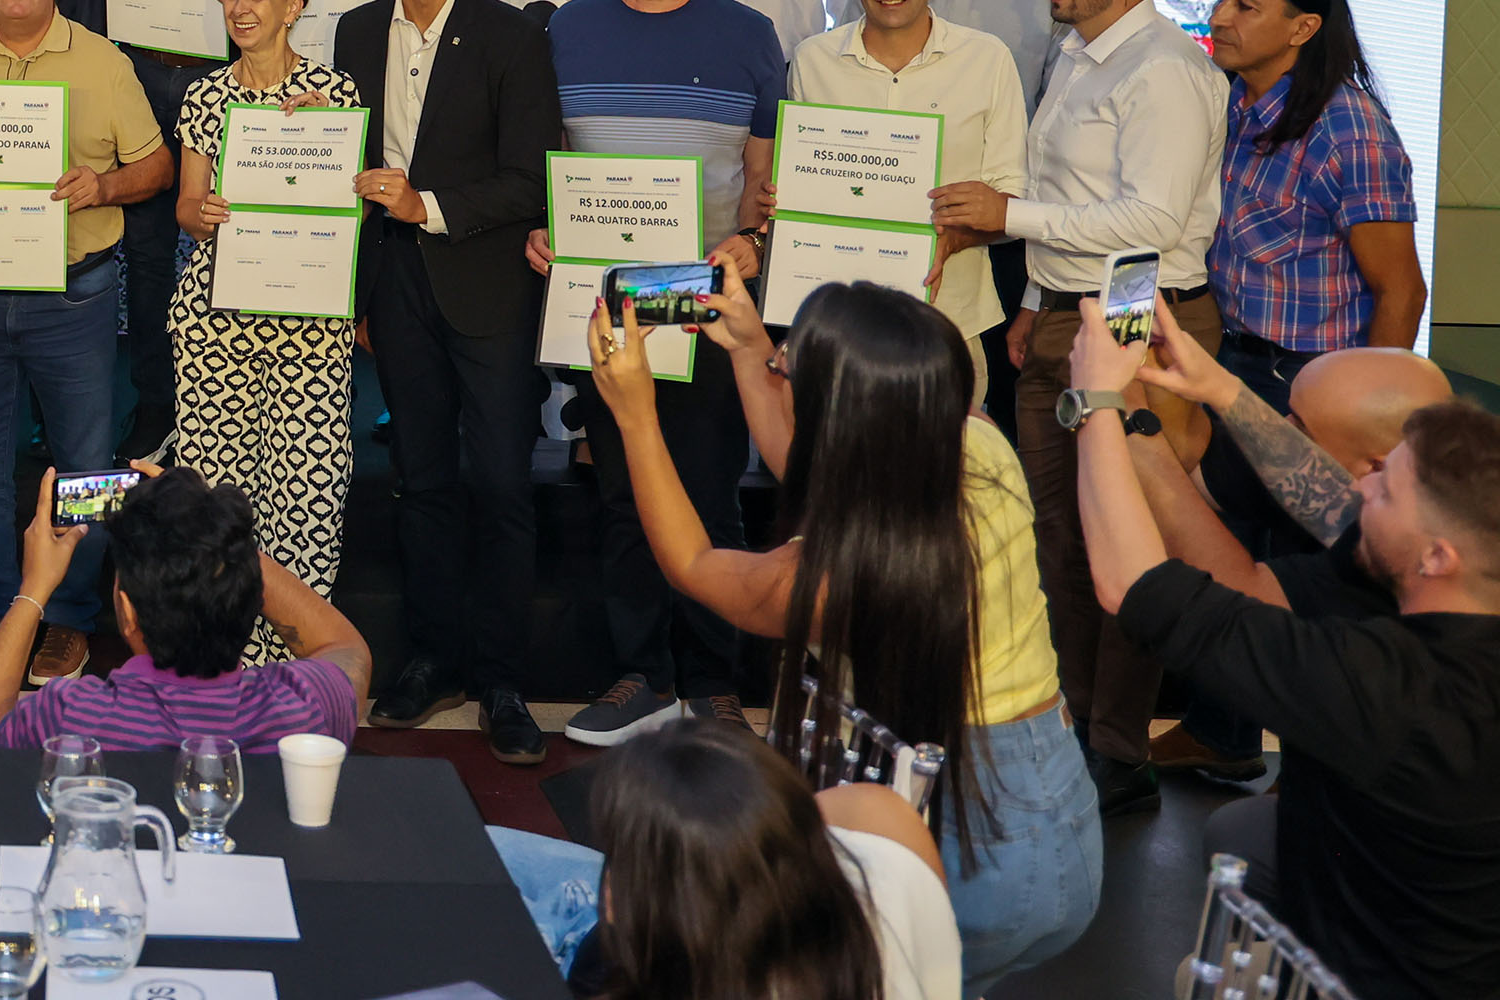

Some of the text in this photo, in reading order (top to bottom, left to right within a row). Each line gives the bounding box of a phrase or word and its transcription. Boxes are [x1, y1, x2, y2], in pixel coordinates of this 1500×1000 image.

[13, 140, 50, 149] PARANÁ
[251, 147, 332, 157] R$ 53.000.000,00
[259, 160, 273, 168] SÃO
[795, 165, 818, 174] PARA
[820, 168, 862, 179] CRUZEIRO
[881, 175, 915, 184] IGUAÇU
[580, 198, 667, 211] R$ 12.000.000,00
[570, 214, 678, 227] PARA QUATRO BARRAS
